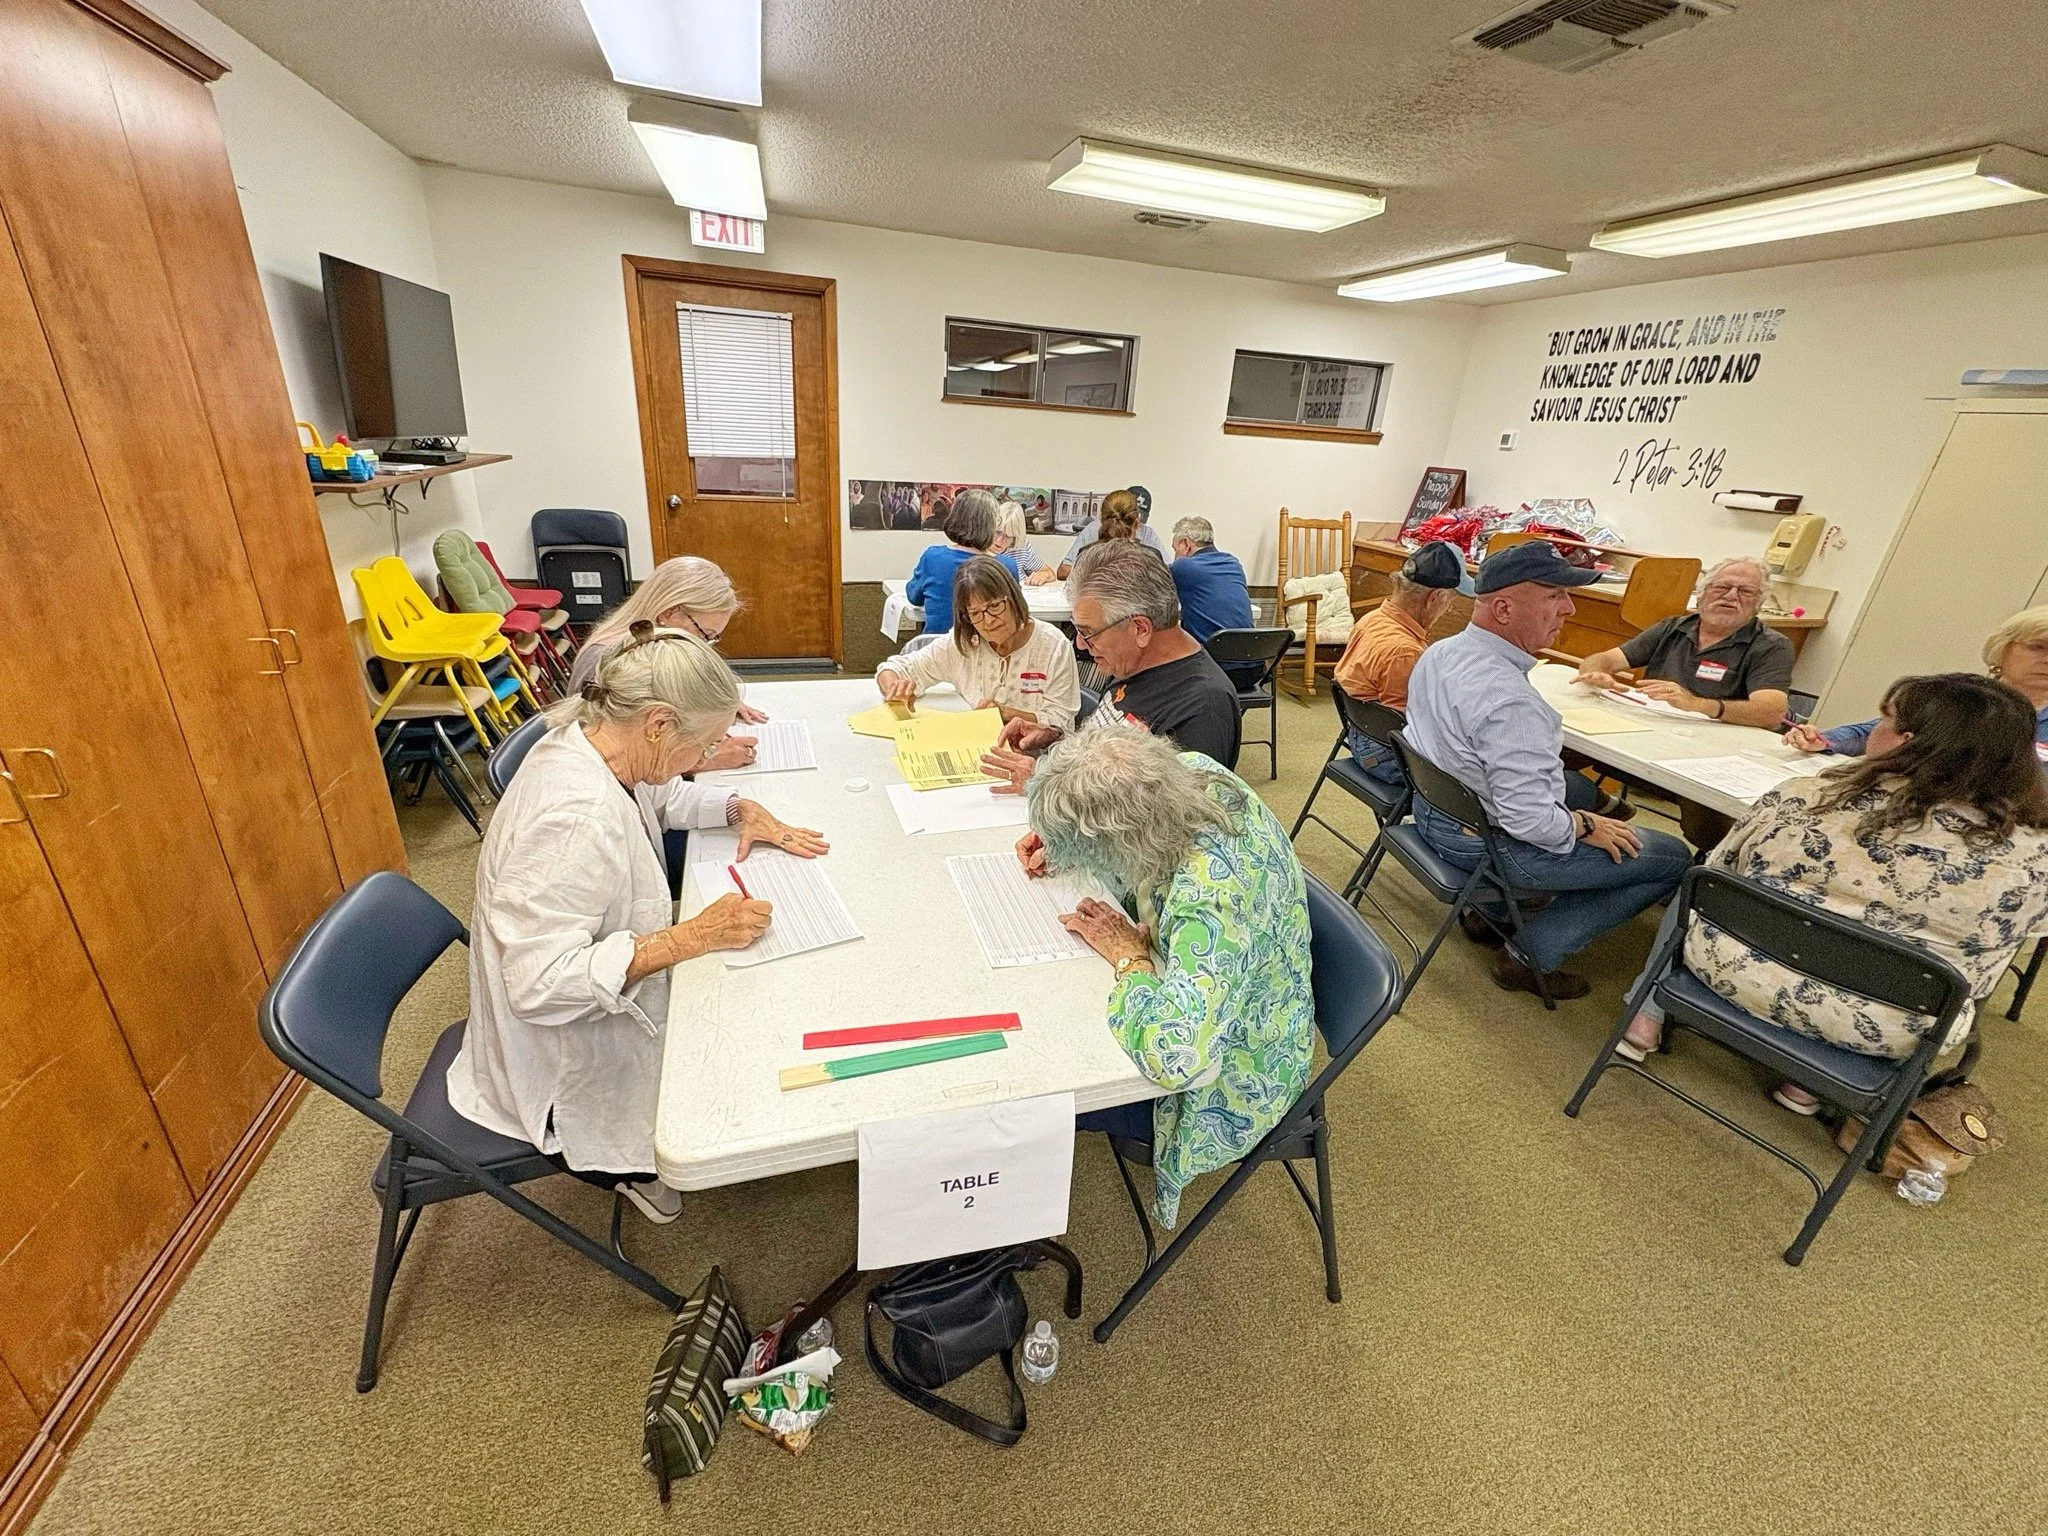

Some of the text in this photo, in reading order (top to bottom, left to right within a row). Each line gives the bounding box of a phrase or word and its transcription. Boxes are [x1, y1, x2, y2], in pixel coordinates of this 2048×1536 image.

[700, 210, 750, 246] EXIT
[1574, 326, 1613, 355] GROW
[1613, 324, 1632, 352] IN
[1630, 319, 1684, 351] GRACE,
[1686, 314, 1726, 347] AND
[1724, 312, 1748, 344] IN
[1747, 308, 1786, 343] THE
[1539, 352, 1761, 390] KNOWLEDGE OF OUR LORD AND
[1530, 396, 1583, 422] SAVIOUR
[1583, 396, 1628, 423] JESUS
[1612, 437, 1727, 494] 2 Peter 3:18
[1416, 495, 1449, 516] Sunday
[940, 1171, 1000, 1193] TABLE
[963, 1195, 976, 1210] 2
